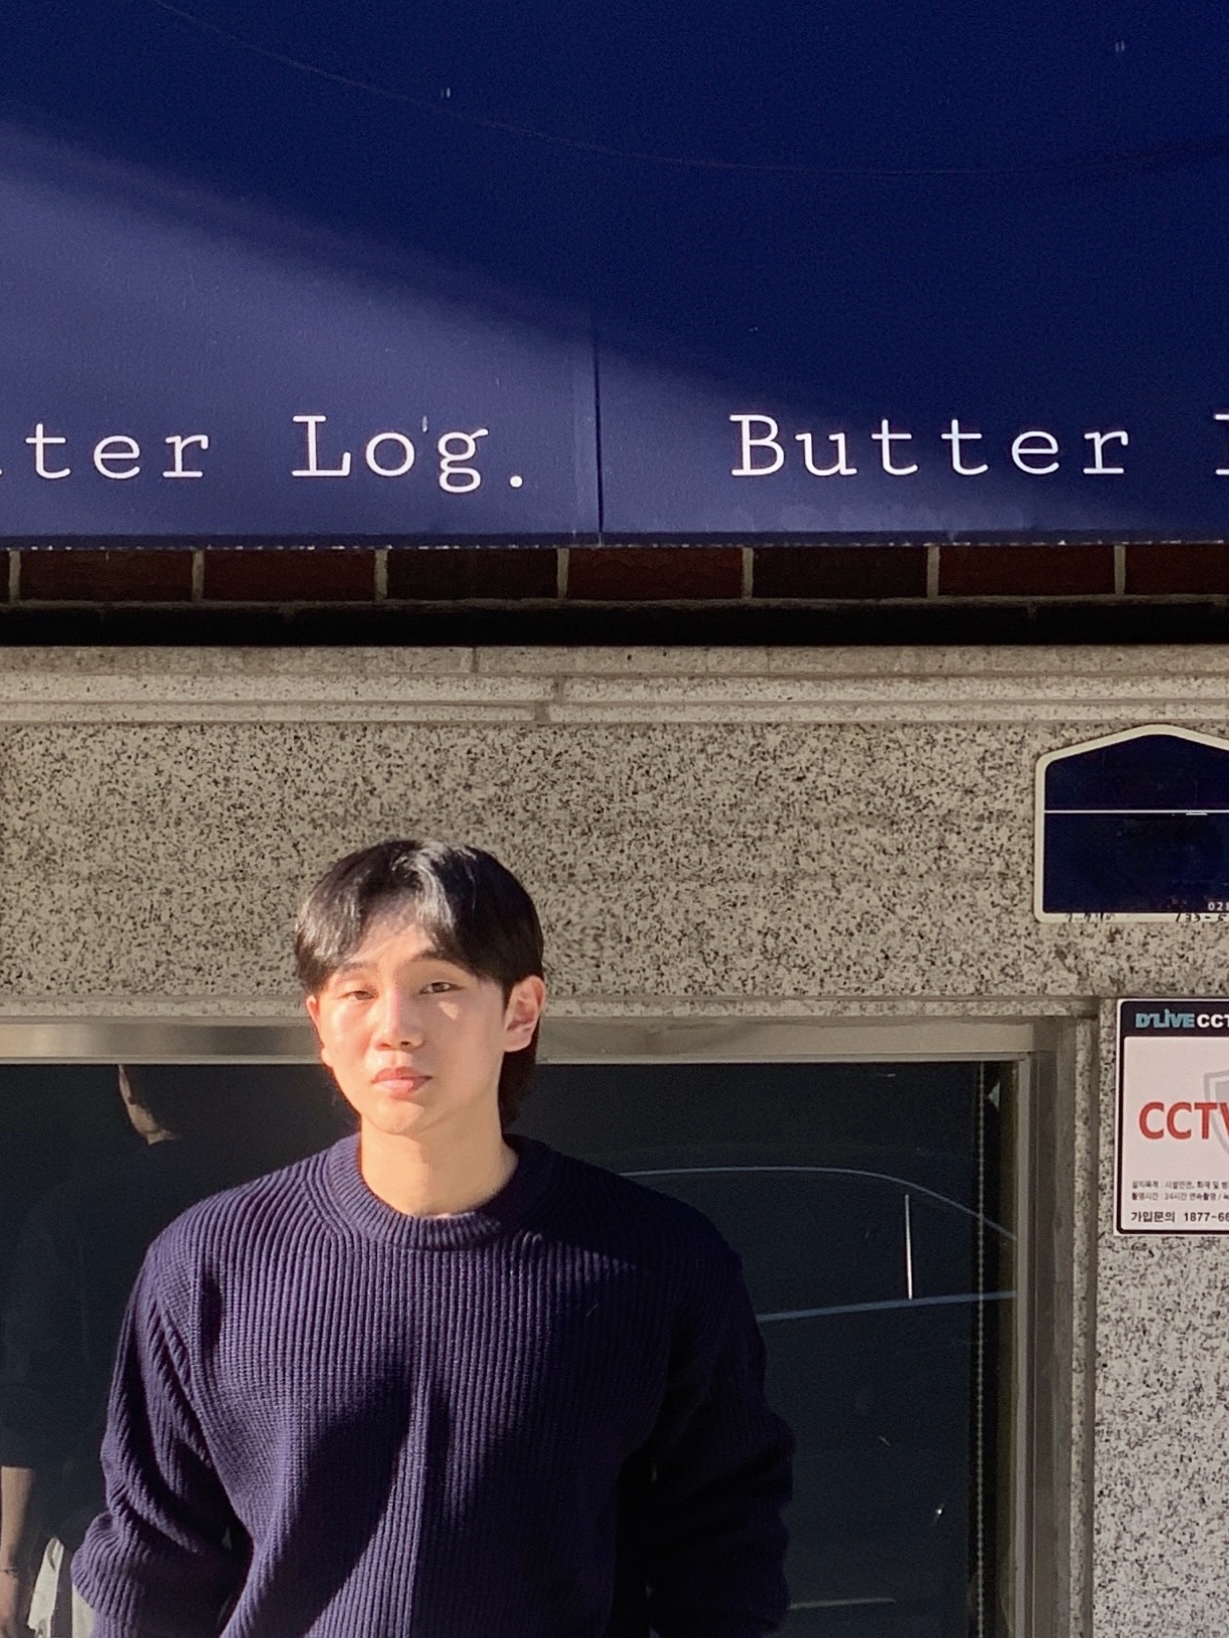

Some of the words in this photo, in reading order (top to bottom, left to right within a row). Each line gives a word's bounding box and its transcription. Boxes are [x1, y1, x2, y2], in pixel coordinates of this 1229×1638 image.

[292, 415, 523, 494] Log.
[729, 414, 1129, 476] Butter
[1131, 1211, 1175, 1222] 가입문의
